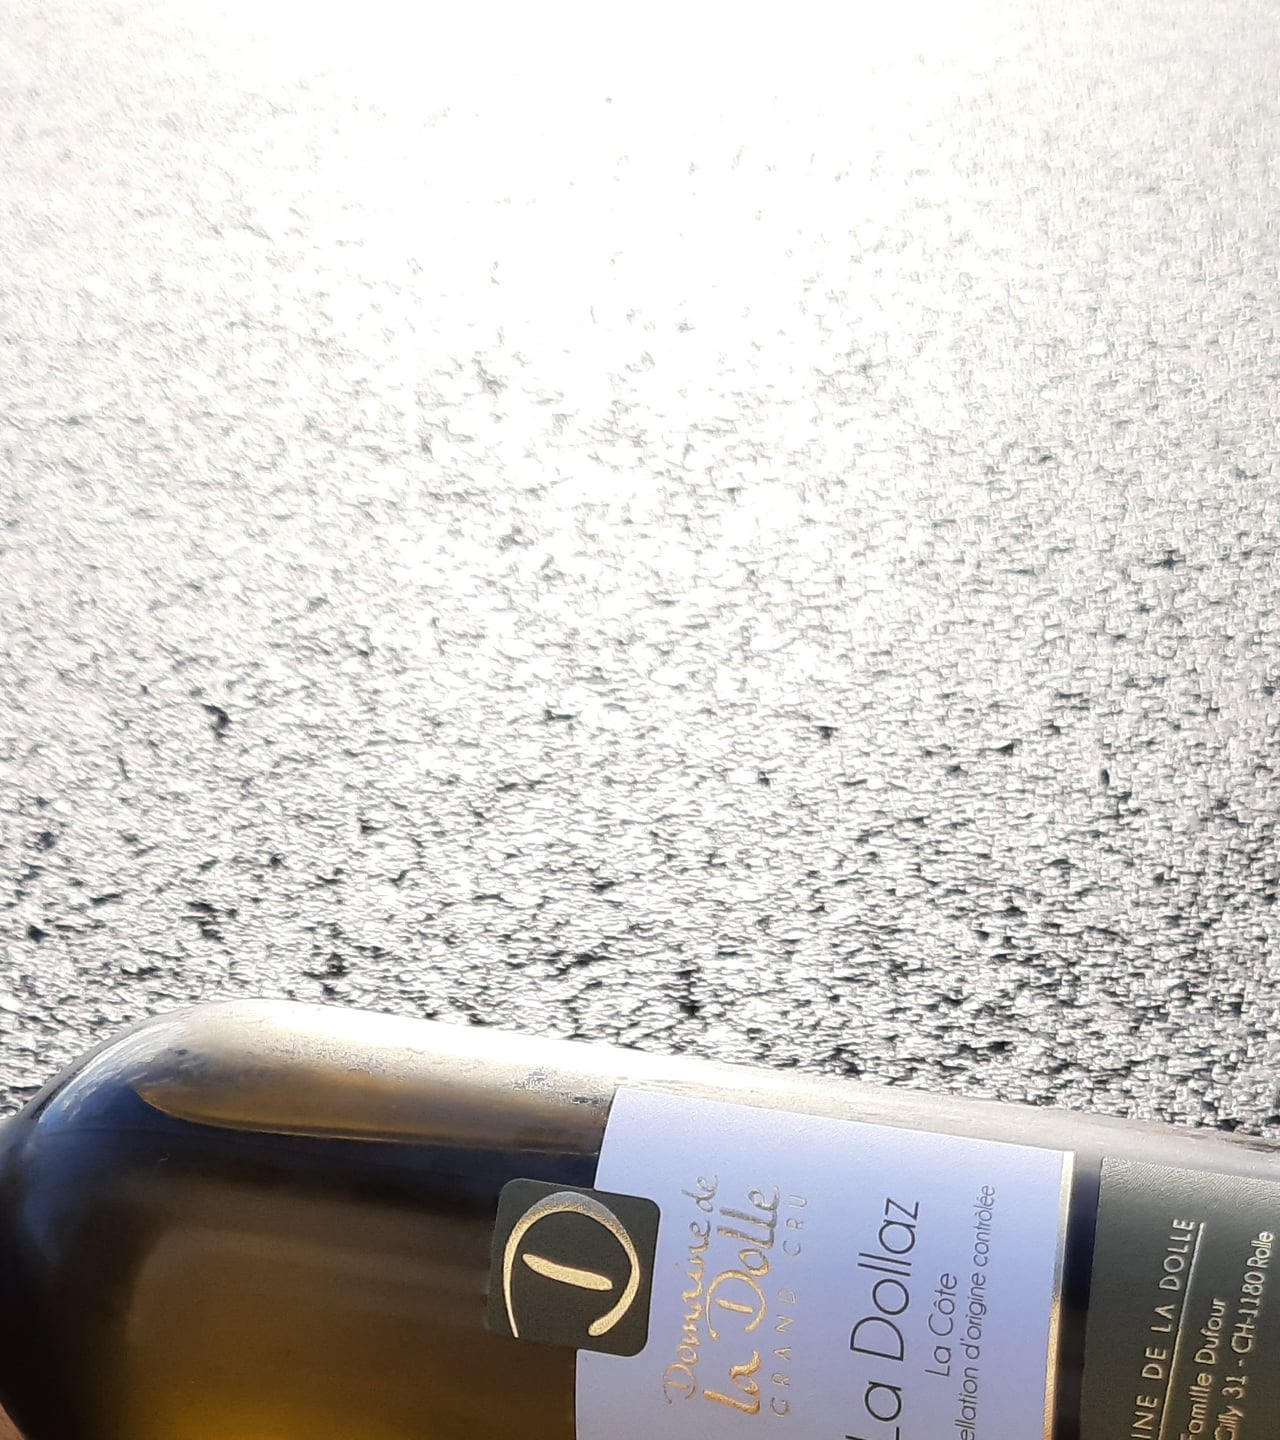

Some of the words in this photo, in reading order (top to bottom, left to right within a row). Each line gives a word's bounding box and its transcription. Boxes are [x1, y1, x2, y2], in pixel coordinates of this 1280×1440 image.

[682, 1174, 718, 1213] de
[782, 1194, 808, 1257] CRU
[972, 1184, 996, 1268] contrôlée
[705, 1184, 781, 1342] Dolle
[850, 1197, 920, 1362] Dollaz
[1158, 1218, 1195, 1291] DOLLE
[1247, 1230, 1275, 1269] Rolle
[662, 1220, 711, 1404] Domaine
[928, 1272, 958, 1337] Côte
[959, 1272, 988, 1360] d'origine
[1150, 1303, 1176, 1333] LA
[1193, 1298, 1227, 1366] Dufour
[1231, 1271, 1265, 1354] CH-1180
[770, 1287, 797, 1418] GRAND
[924, 1345, 952, 1377] La
[1140, 1347, 1168, 1380] DE
[1222, 1375, 1248, 1400] 31
